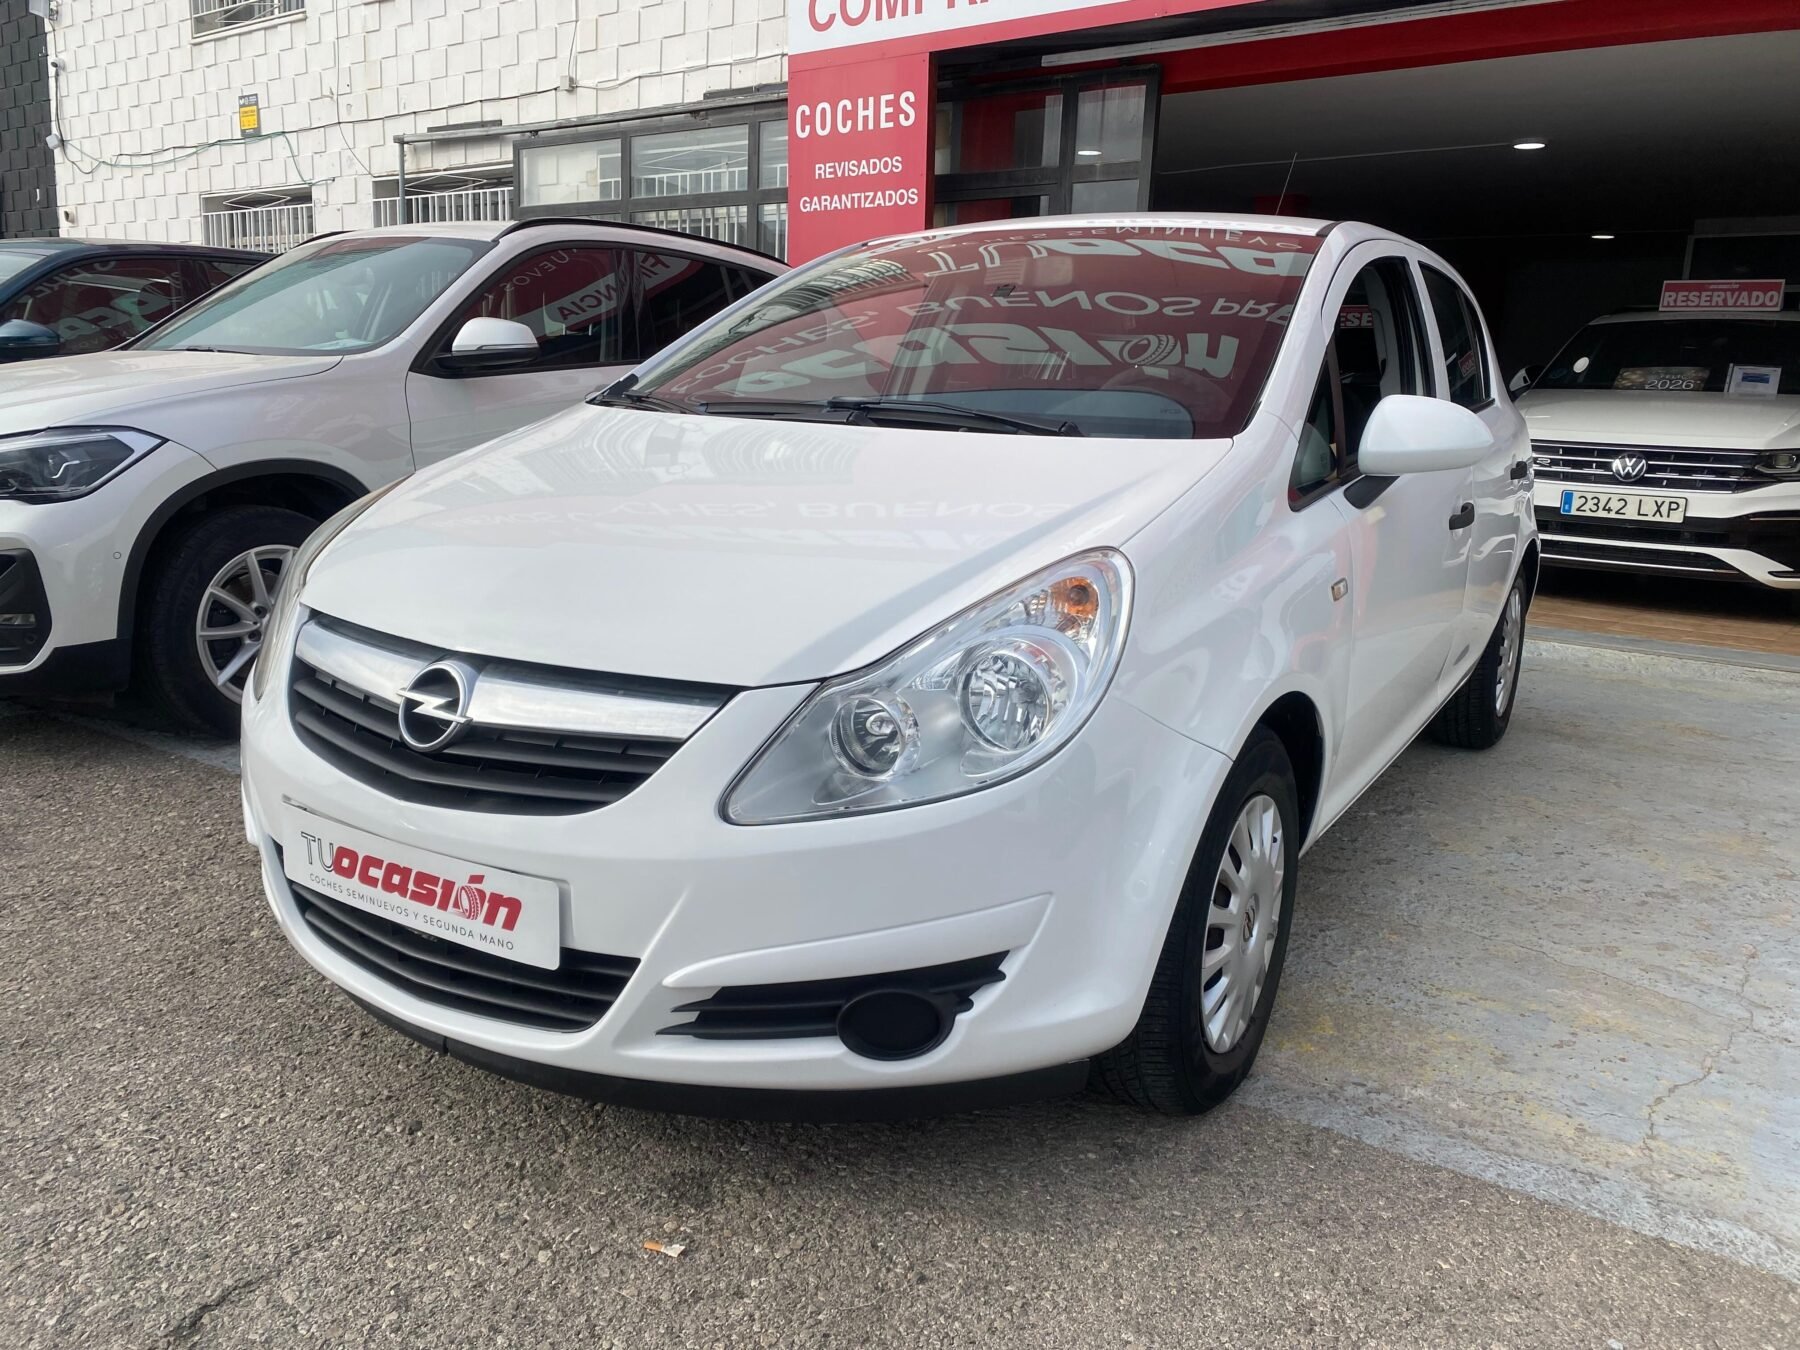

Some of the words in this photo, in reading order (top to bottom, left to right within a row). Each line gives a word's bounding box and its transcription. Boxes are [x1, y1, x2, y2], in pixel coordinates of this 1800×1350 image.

[795, 91, 916, 138] COCHES
[815, 156, 902, 179] REVISADOS
[800, 188, 918, 212] GARANTIZADOS
[1662, 291, 1779, 306] RESERVADO
[1645, 379, 1694, 390] 2026
[1576, 495, 1628, 515] 2342
[1637, 498, 1680, 518] LXP
[309, 872, 343, 894] COCHES
[346, 887, 409, 918] SEMINUEVOS
[412, 911, 420, 920] Y
[423, 914, 475, 939] SEGUNDA
[479, 933, 514, 951] MANO
